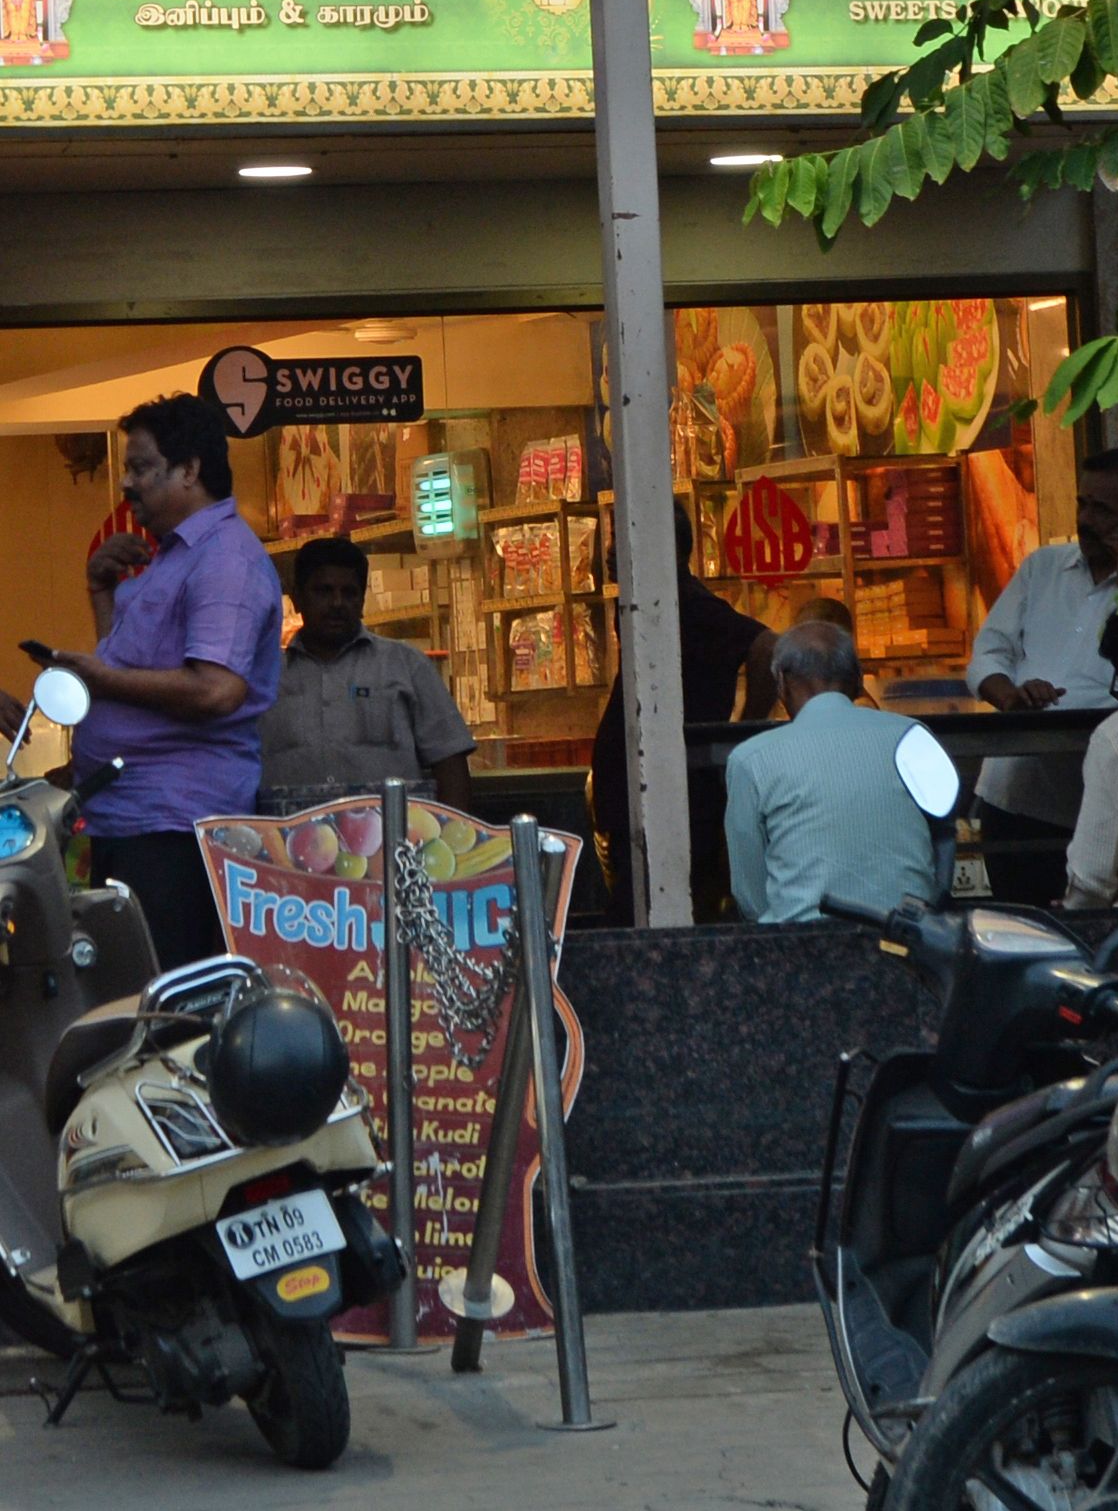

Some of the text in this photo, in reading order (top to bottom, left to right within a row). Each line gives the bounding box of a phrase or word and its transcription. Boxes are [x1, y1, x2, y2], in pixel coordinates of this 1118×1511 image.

[849, 0, 957, 21] SWEETS
[276, 365, 413, 393] SWIGGY
[275, 394, 417, 408] FOOD DELIVERY APP
[223, 858, 368, 951] Fresh
[347, 959, 438, 985] Ale
[342, 991, 441, 1021] Mago
[338, 1019, 446, 1055] Orage
[421, 1119, 481, 1145] Kudi
[253, 1207, 305, 1238] TN 09
[252, 1231, 324, 1267] CM 0583
